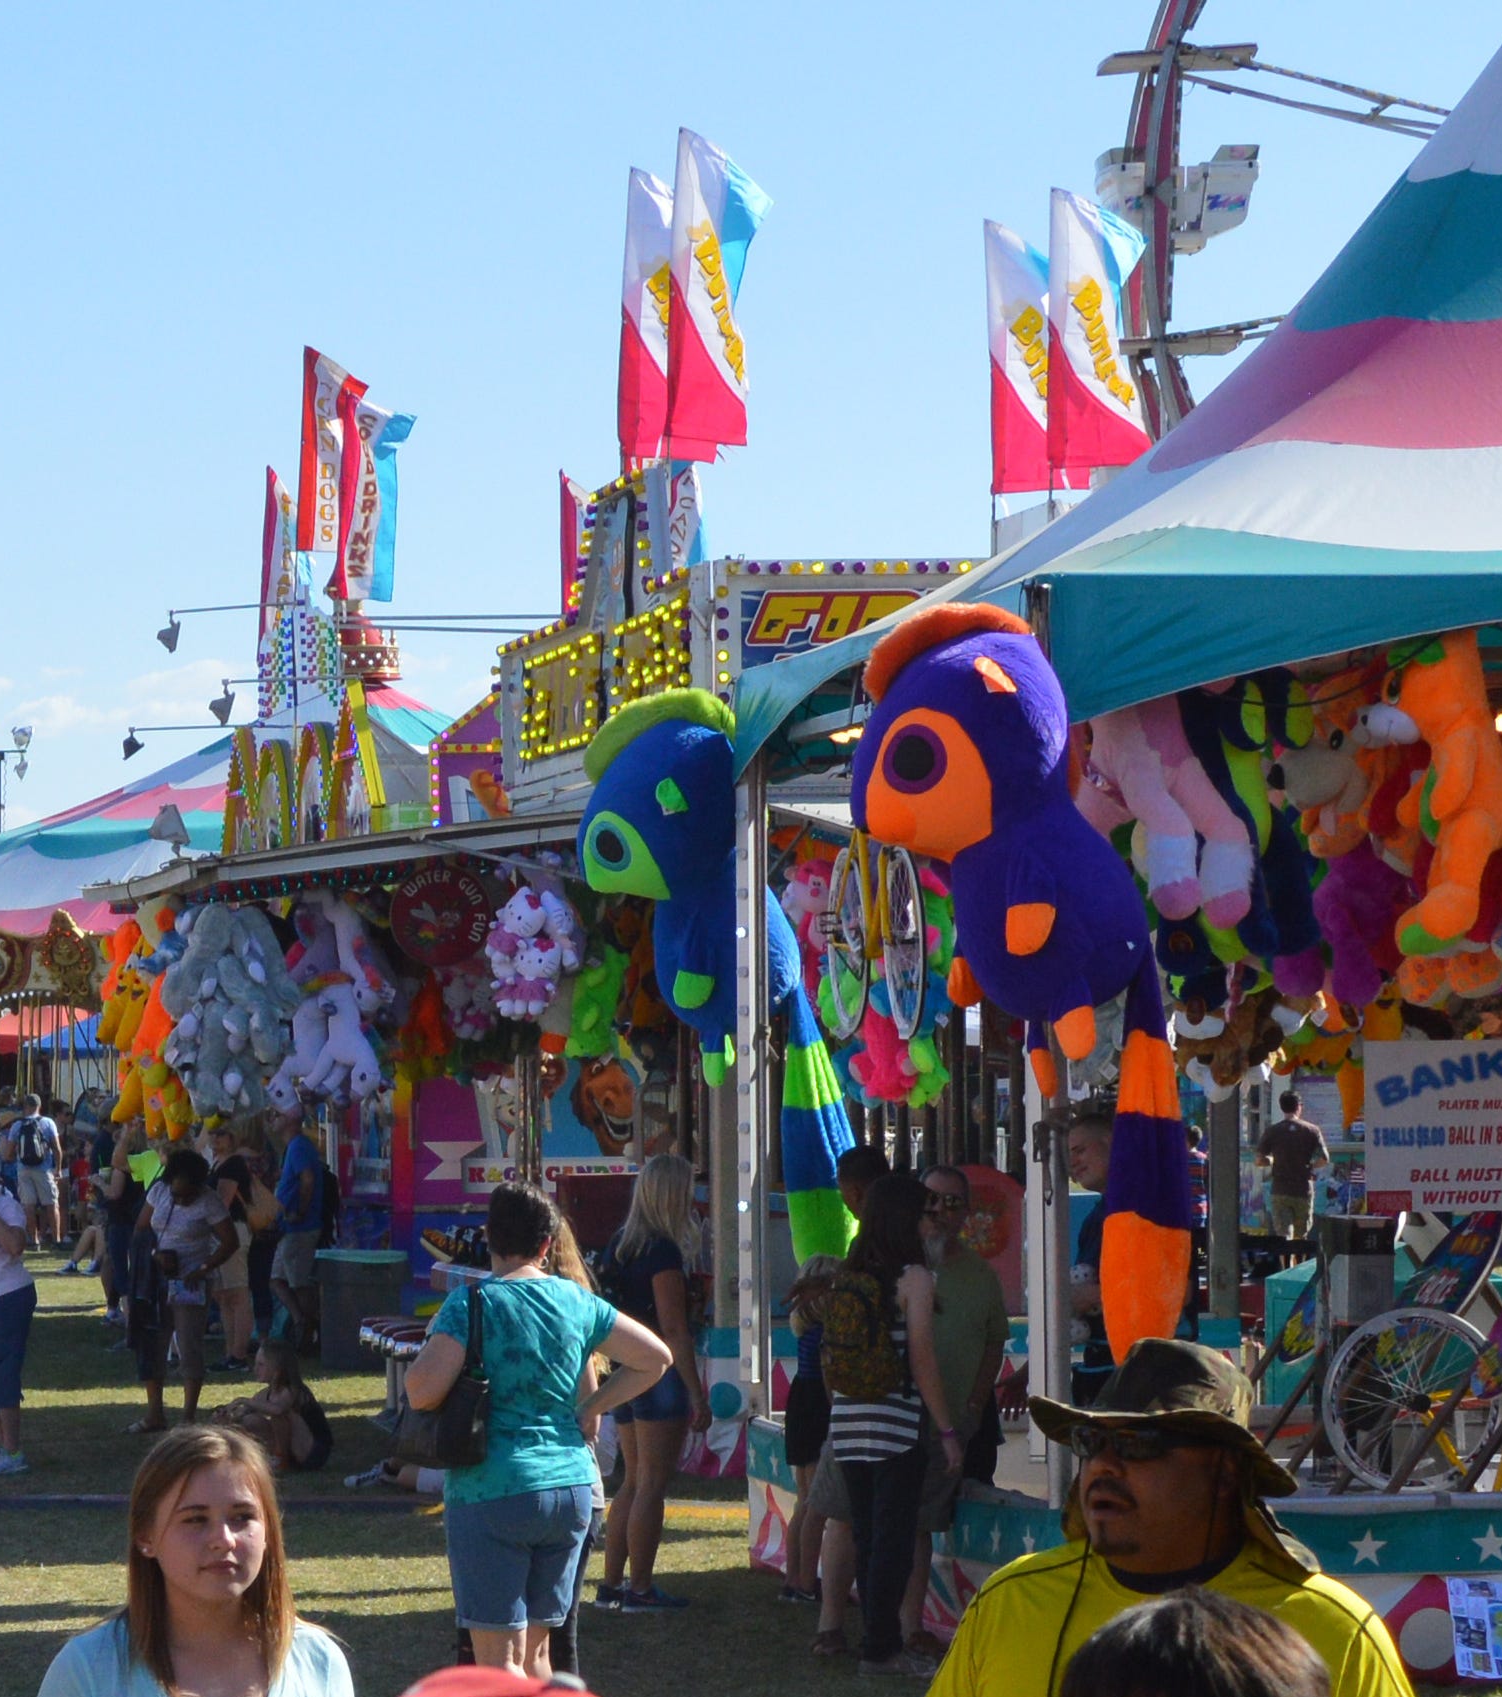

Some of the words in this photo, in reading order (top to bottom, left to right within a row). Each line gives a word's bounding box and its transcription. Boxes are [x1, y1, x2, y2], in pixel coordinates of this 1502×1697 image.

[318, 462, 338, 543] DOGS
[346, 481, 379, 578] DRINKS
[402, 869, 452, 898] WATER
[458, 877, 483, 906] GUN
[467, 912, 487, 943] FUN
[1438, 1099, 1479, 1111] PLAYER
[1448, 1126, 1476, 1146] BALL
[1479, 1126, 1493, 1145] IN
[1410, 1167, 1450, 1183] BALL
